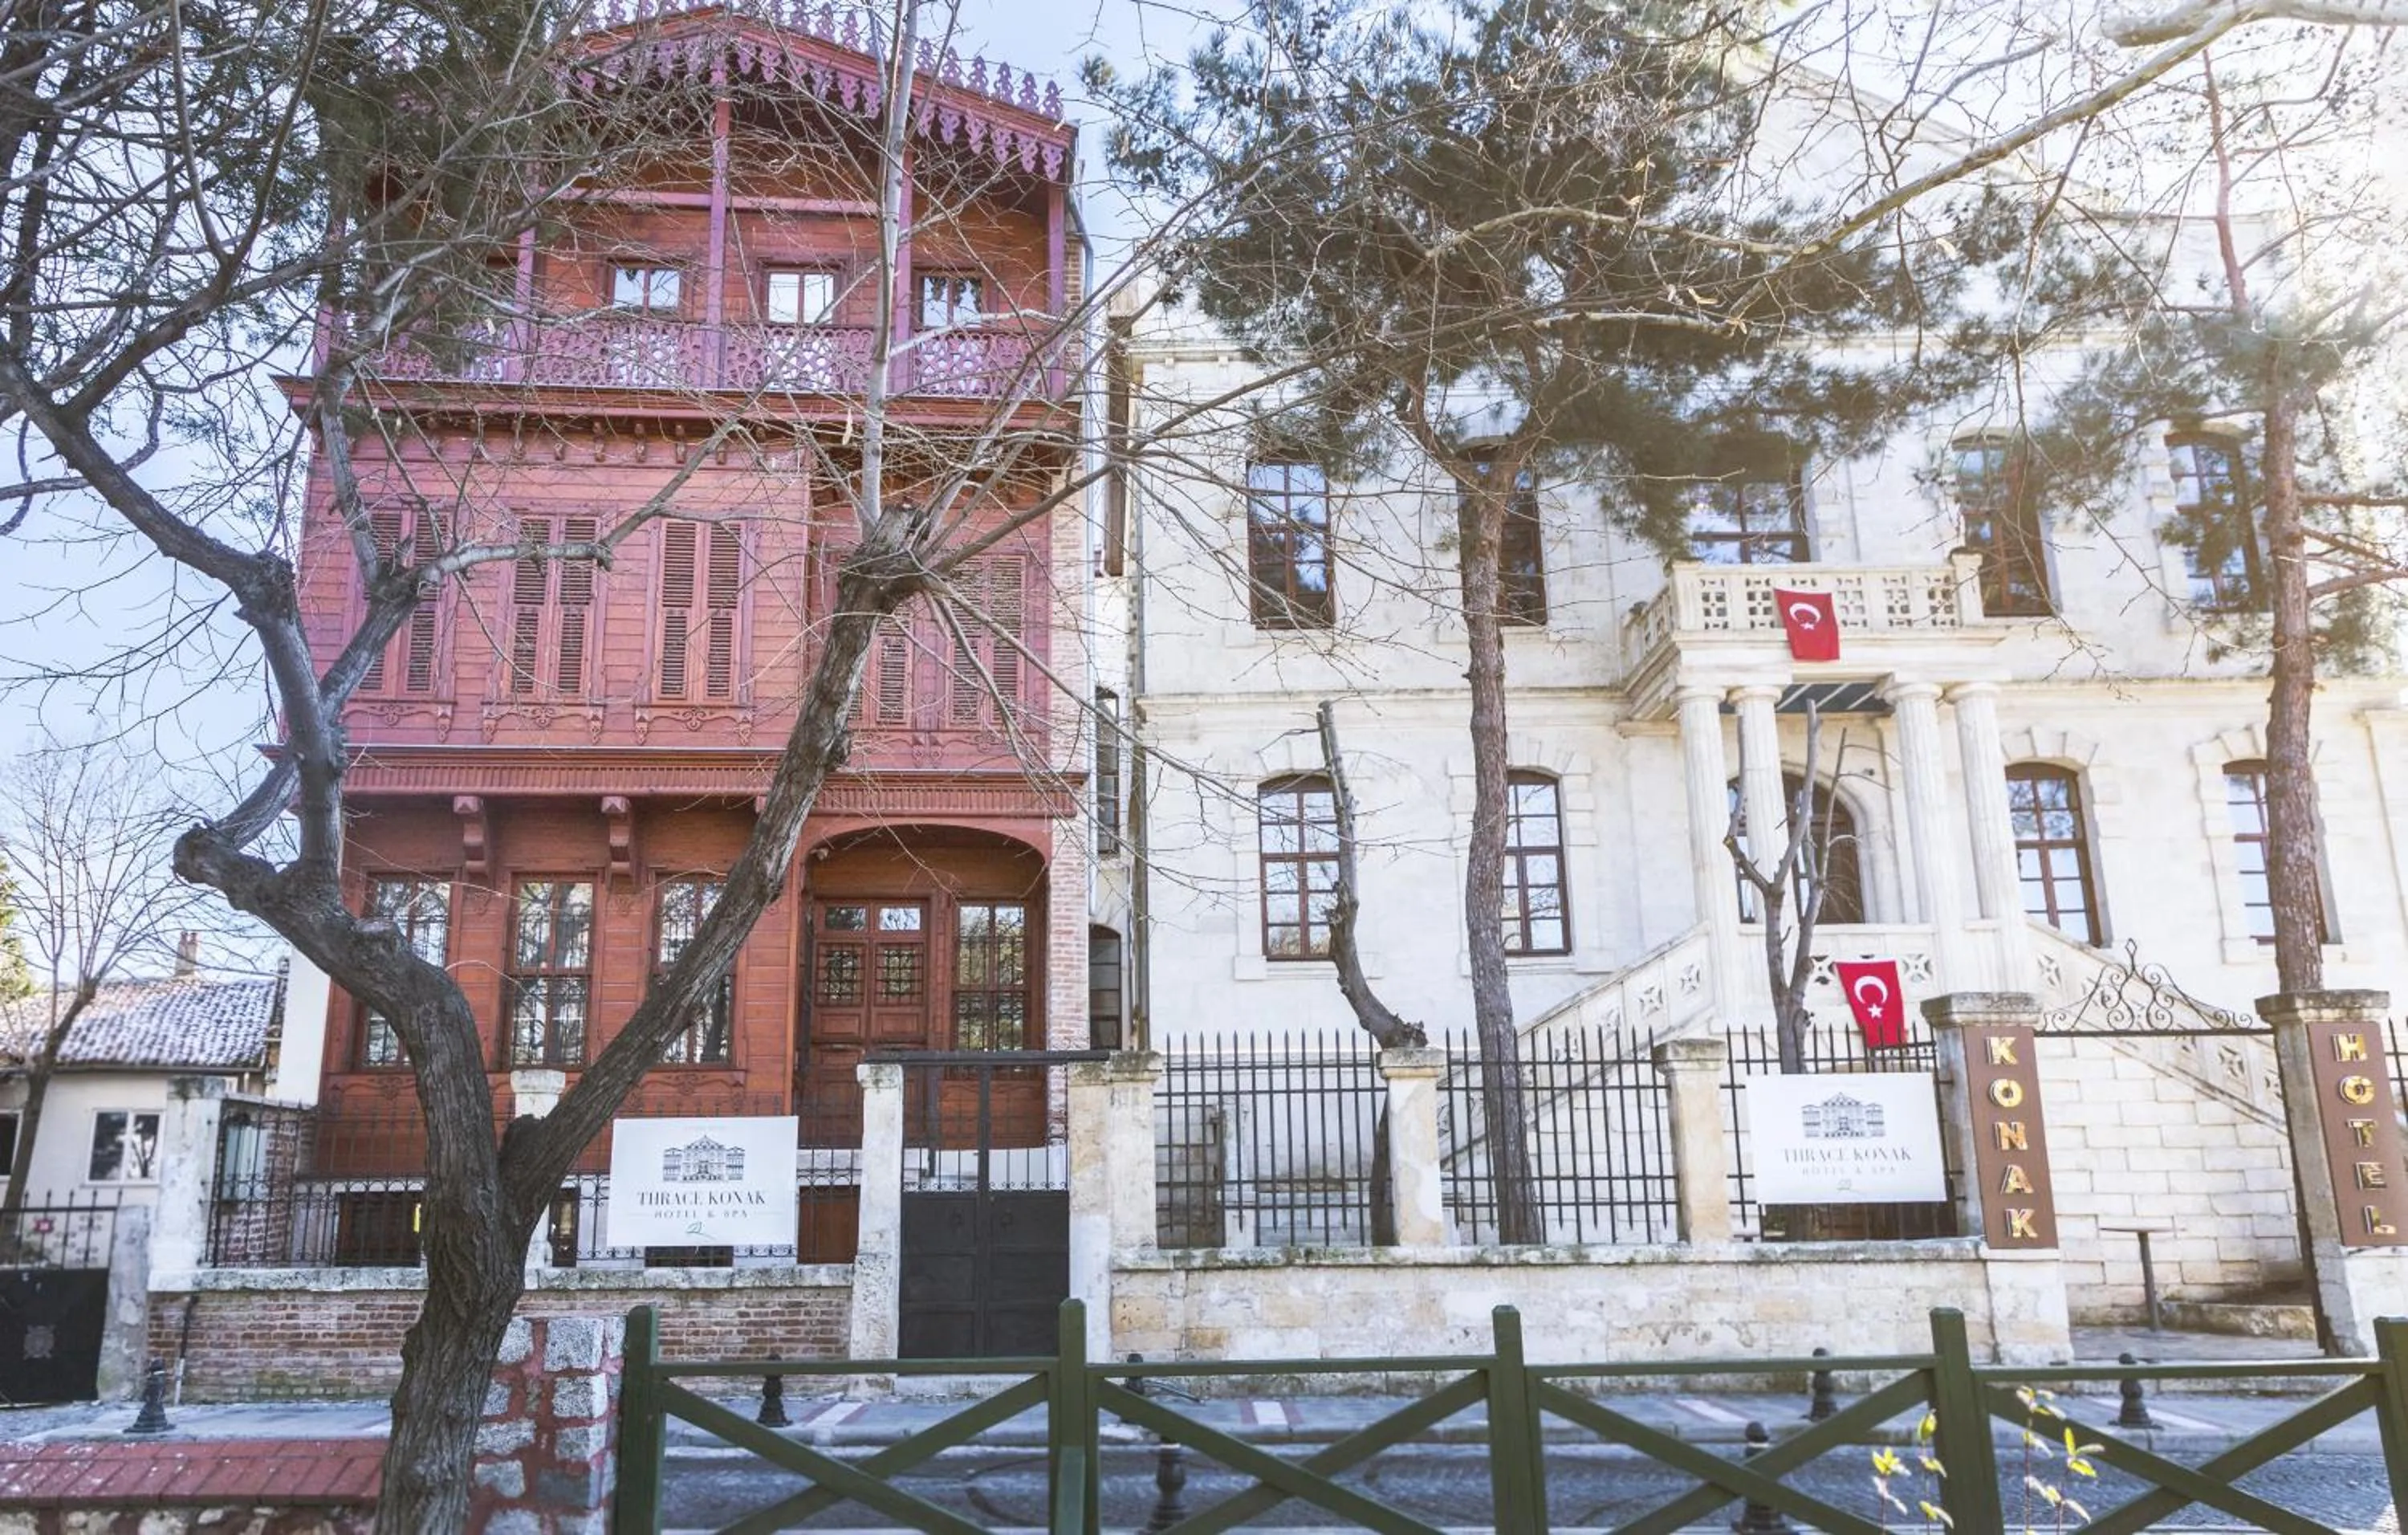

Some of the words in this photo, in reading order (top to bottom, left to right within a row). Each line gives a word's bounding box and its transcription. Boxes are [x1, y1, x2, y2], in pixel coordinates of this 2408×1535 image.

[1853, 1146, 1911, 1161] KONAK
[1986, 1036, 2039, 1239] KONAK
[2332, 1033, 2397, 1235] HOTEL
[637, 1191, 704, 1205] THRACE
[709, 1190, 766, 1205] KONAK
